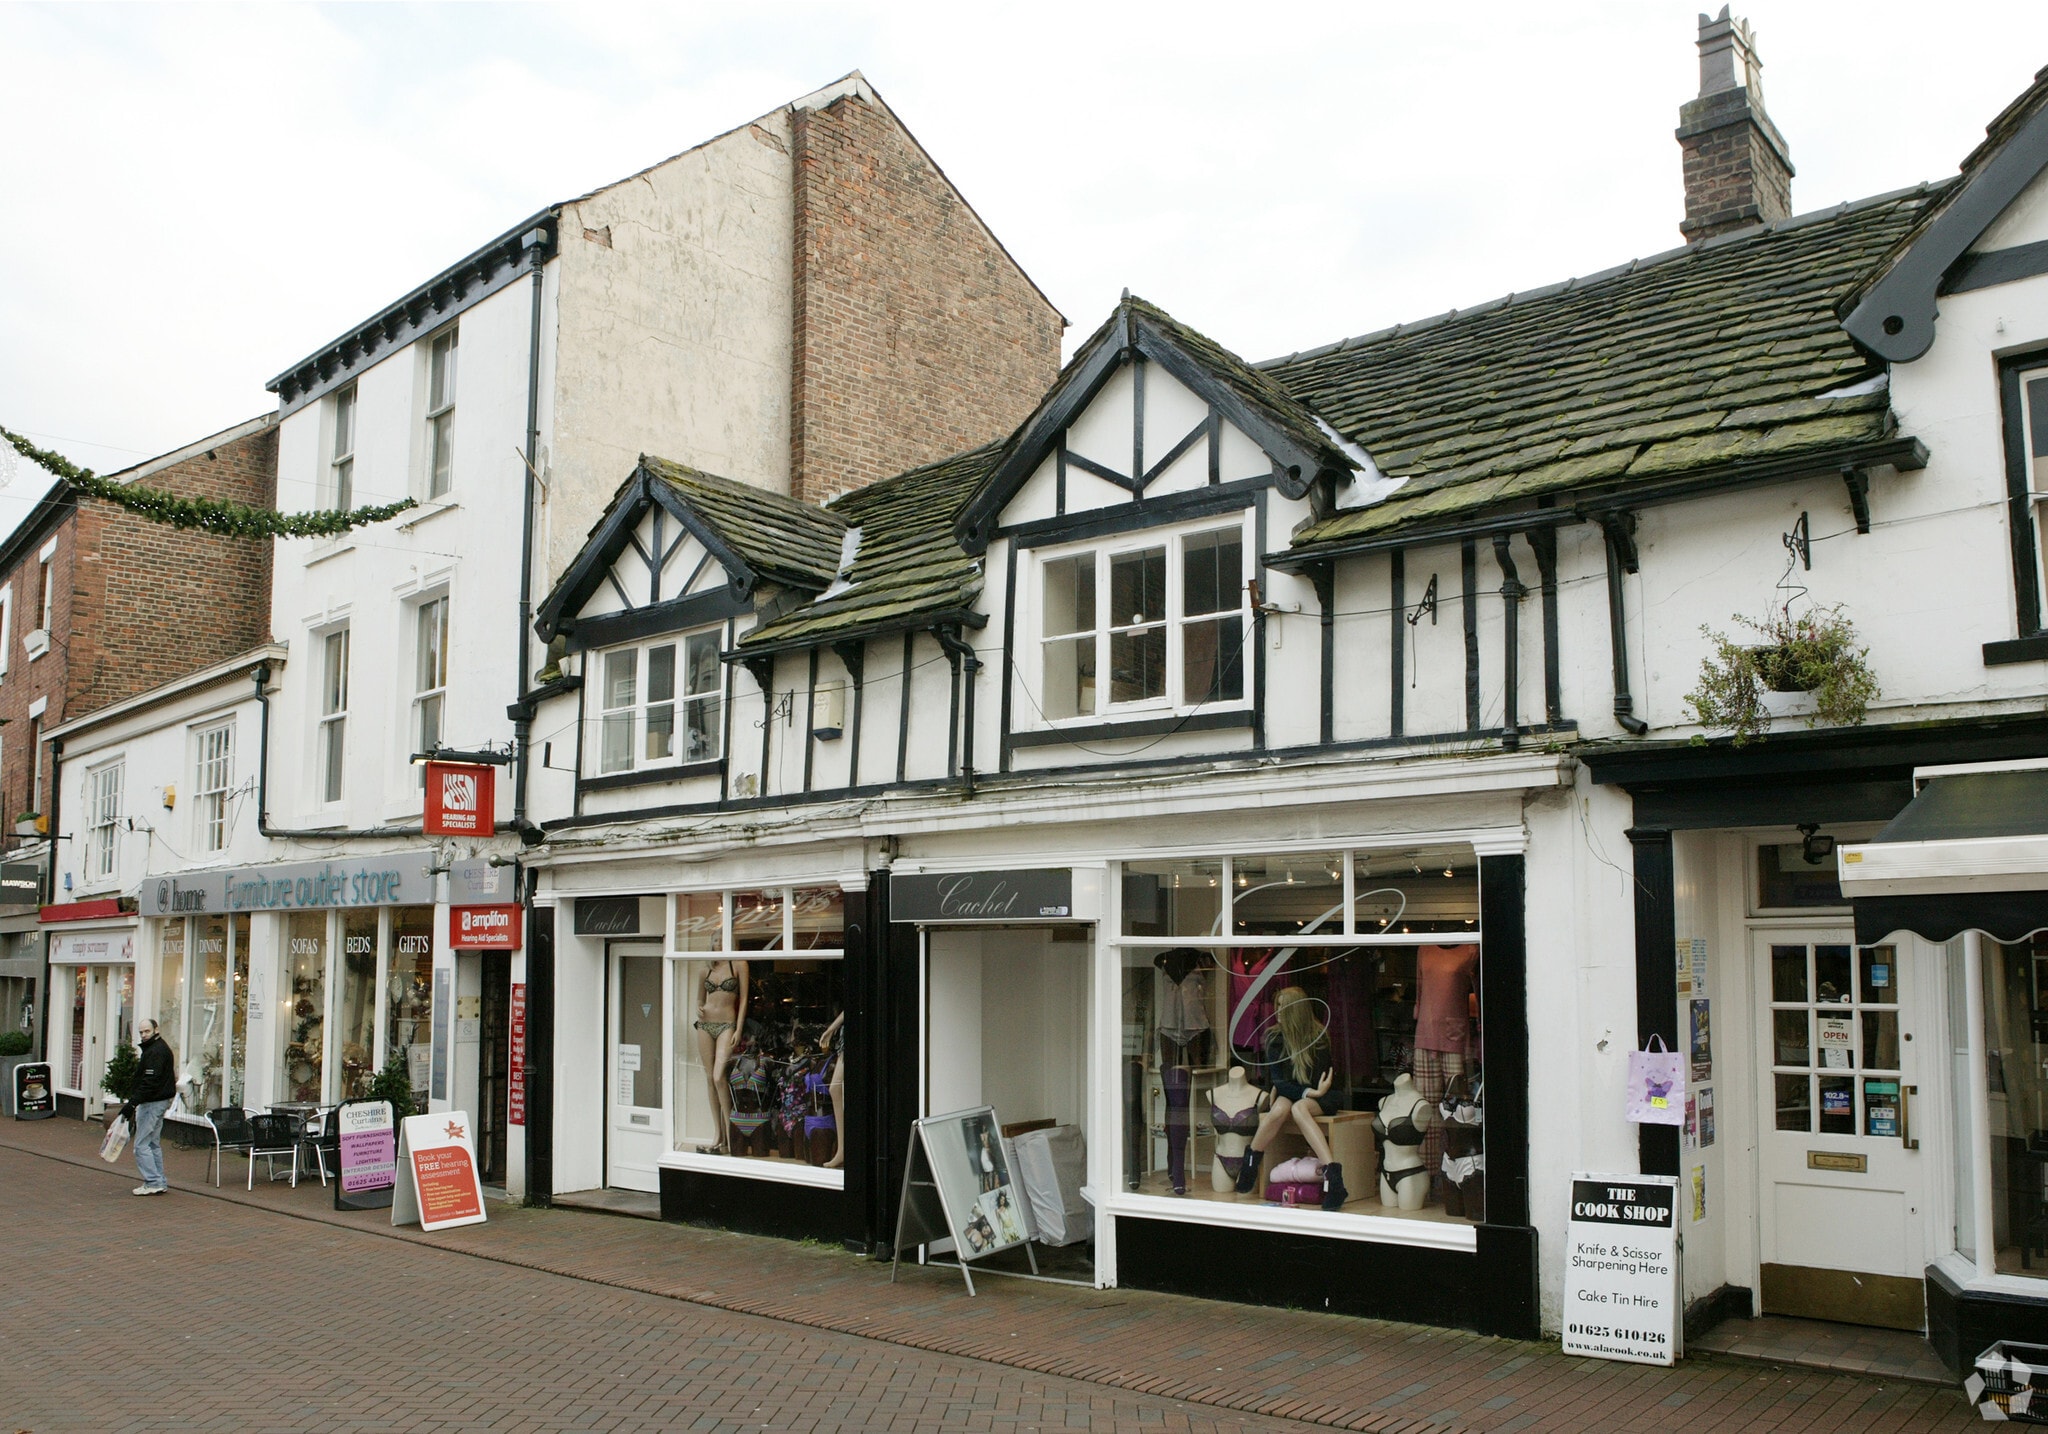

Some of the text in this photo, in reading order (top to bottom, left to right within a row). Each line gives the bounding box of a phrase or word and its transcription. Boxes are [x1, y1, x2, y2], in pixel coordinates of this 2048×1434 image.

[442, 821, 476, 829] SPECIALISTS
[466, 814, 476, 822] AID
[224, 864, 400, 909] Furniture outlet store
[171, 879, 206, 912] home
[937, 875, 1019, 916] Cachet
[472, 912, 508, 929] amplifon
[346, 936, 370, 954] BEDS
[399, 935, 429, 954] GIFTS
[462, 934, 508, 943] Hearing Aid Specialists
[199, 939, 222, 953] DINING
[292, 938, 318, 954] SOFAS
[1824, 1032, 1848, 1040] OPEN
[346, 1108, 386, 1119] CHESHIRE
[352, 1118, 382, 1126] Curtains
[356, 1131, 392, 1140] FURNISHINGS
[351, 1140, 384, 1148] WALLPAPERS
[418, 1152, 452, 1162] Book your
[344, 1163, 394, 1174] INTERIOR DESIGN
[419, 1160, 468, 1172] FREE hearing
[420, 1169, 460, 1180] assessment
[348, 1178, 367, 1186] 01625
[1607, 1188, 1636, 1202] THE
[1574, 1202, 1669, 1222] COOK SHOP
[1578, 1243, 1662, 1260] Knife & Scissor
[1572, 1256, 1668, 1275] Sharpening Here
[1578, 1290, 1659, 1308] Cake Tin Hire
[1569, 1323, 1666, 1344] 01625 610426
[1568, 1342, 1666, 1360] www.alacook.co.uk
